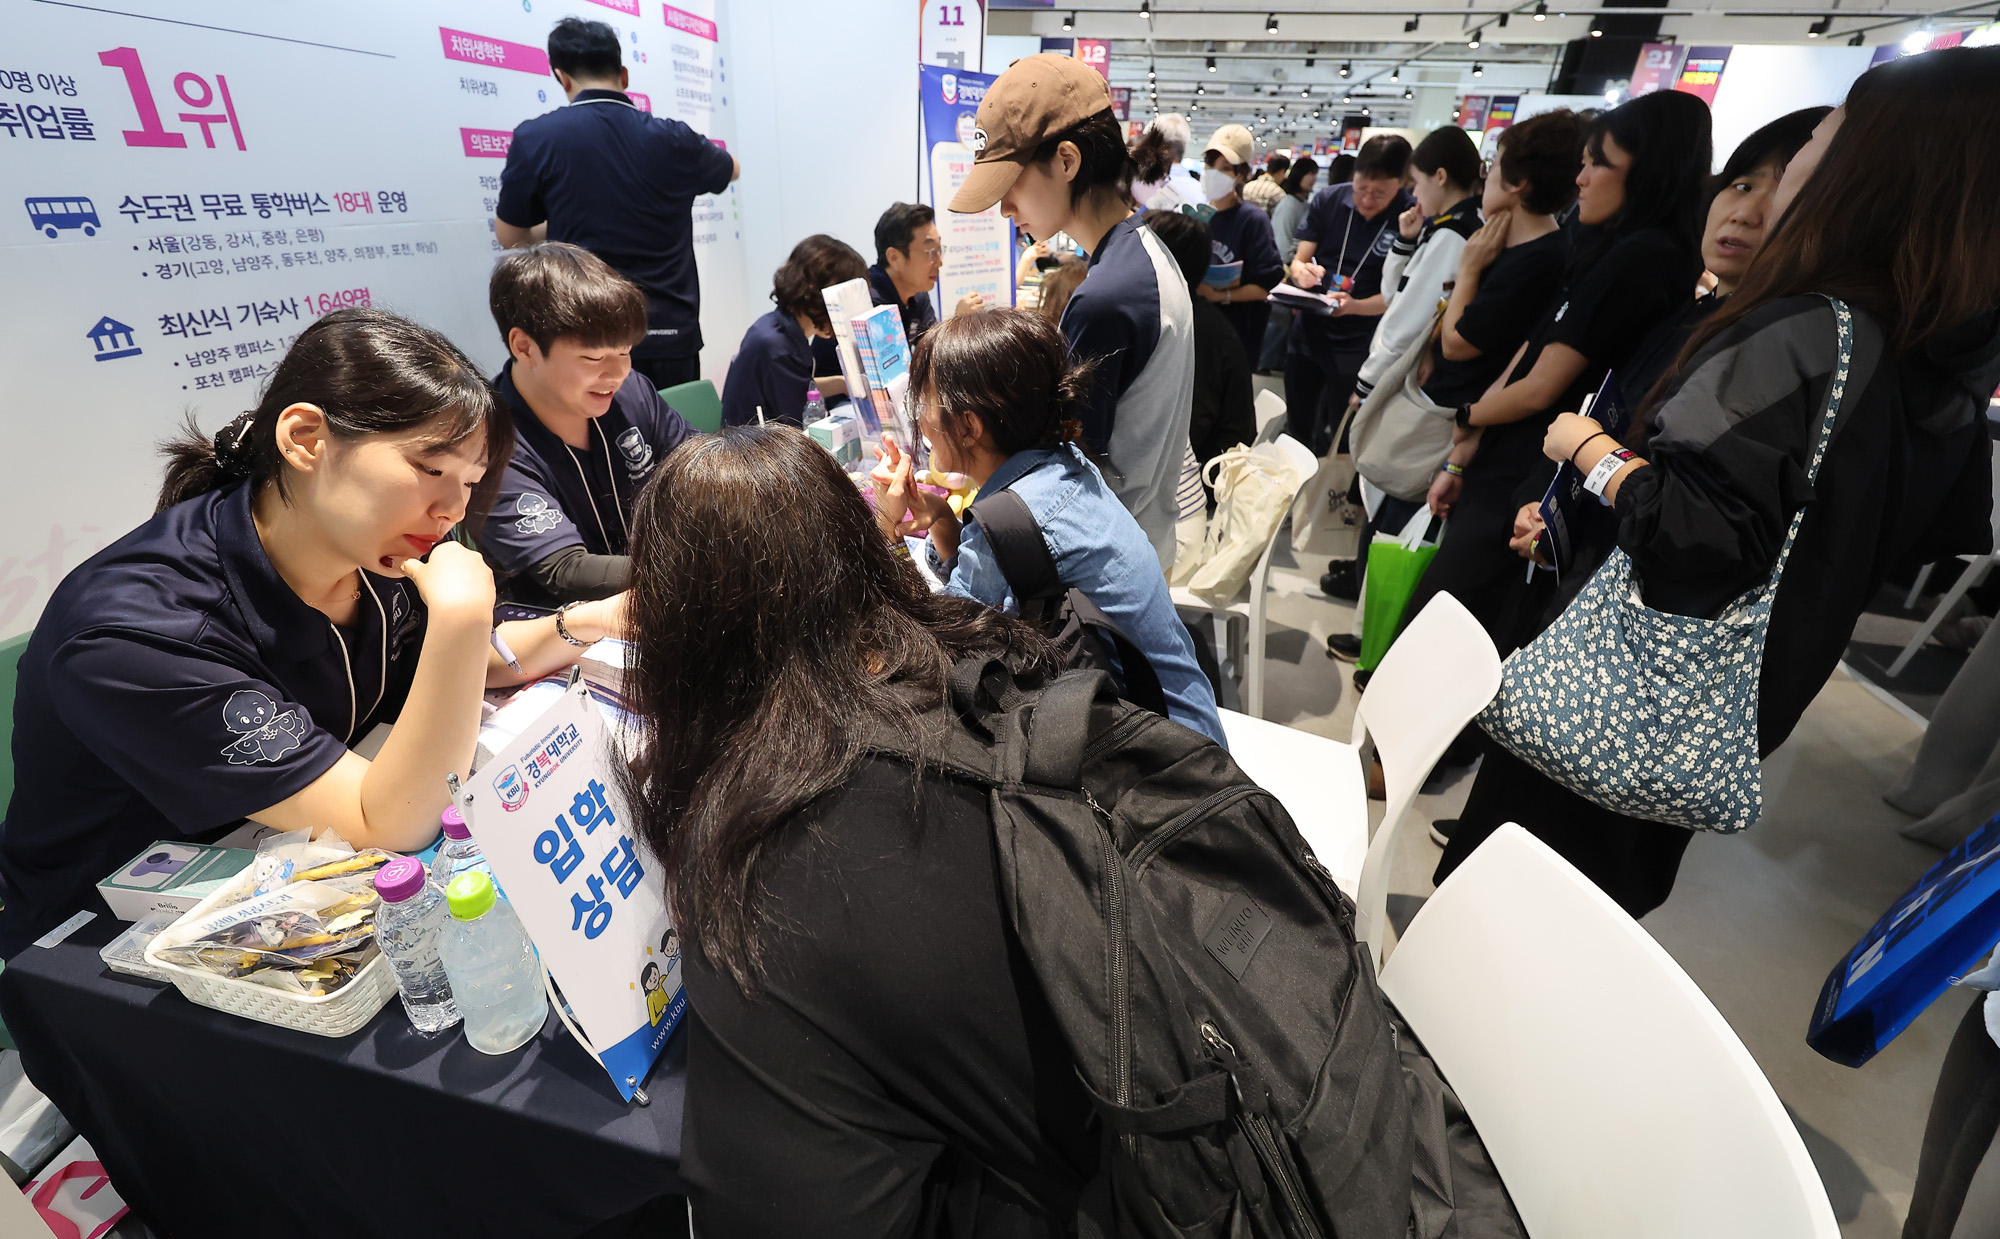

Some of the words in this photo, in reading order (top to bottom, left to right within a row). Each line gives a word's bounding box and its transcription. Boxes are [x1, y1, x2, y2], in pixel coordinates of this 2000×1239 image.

[939, 6, 964, 26] 11
[451, 35, 506, 64] 치위생학부
[1082, 45, 1107, 63] 12
[1645, 50, 1674, 69] 21
[37, 73, 78, 97] 이상
[98, 46, 247, 151] 1위
[460, 77, 498, 97] 치위생과
[0, 102, 96, 141] 취업률
[118, 194, 196, 223] 수도권
[200, 194, 247, 220] 무료
[251, 192, 330, 219] 통학버스
[333, 191, 374, 214] 18대
[378, 190, 408, 213] 운영
[148, 234, 223, 254] 서울(강동,
[225, 231, 260, 249] 강서,
[262, 229, 293, 246] 중랑,
[295, 228, 325, 243] 은평)
[155, 258, 230, 280] 경기(고양,
[232, 254, 279, 273] 남양주,
[281, 250, 323, 268] 동두천,
[324, 249, 352, 263] 양주,
[354, 246, 390, 259] 의정부,
[158, 306, 233, 338] 최신식
[236, 297, 300, 326] 기숙사
[304, 287, 372, 318] 1,649명
[185, 346, 231, 368] 남양주
[233, 339, 276, 359] 캠퍼스
[194, 371, 226, 391] 포천
[228, 364, 268, 384] 캠퍼스
[520, 743, 541, 763] Futuristic
[540, 725, 560, 745] Innovator
[525, 723, 579, 779] 경복대학교
[534, 762, 560, 788] KYUNGBOK
[559, 738, 583, 763] UNIVERSITY
[506, 783, 520, 800] KBU
[533, 778, 616, 885] 입학
[571, 834, 645, 940] 상담
